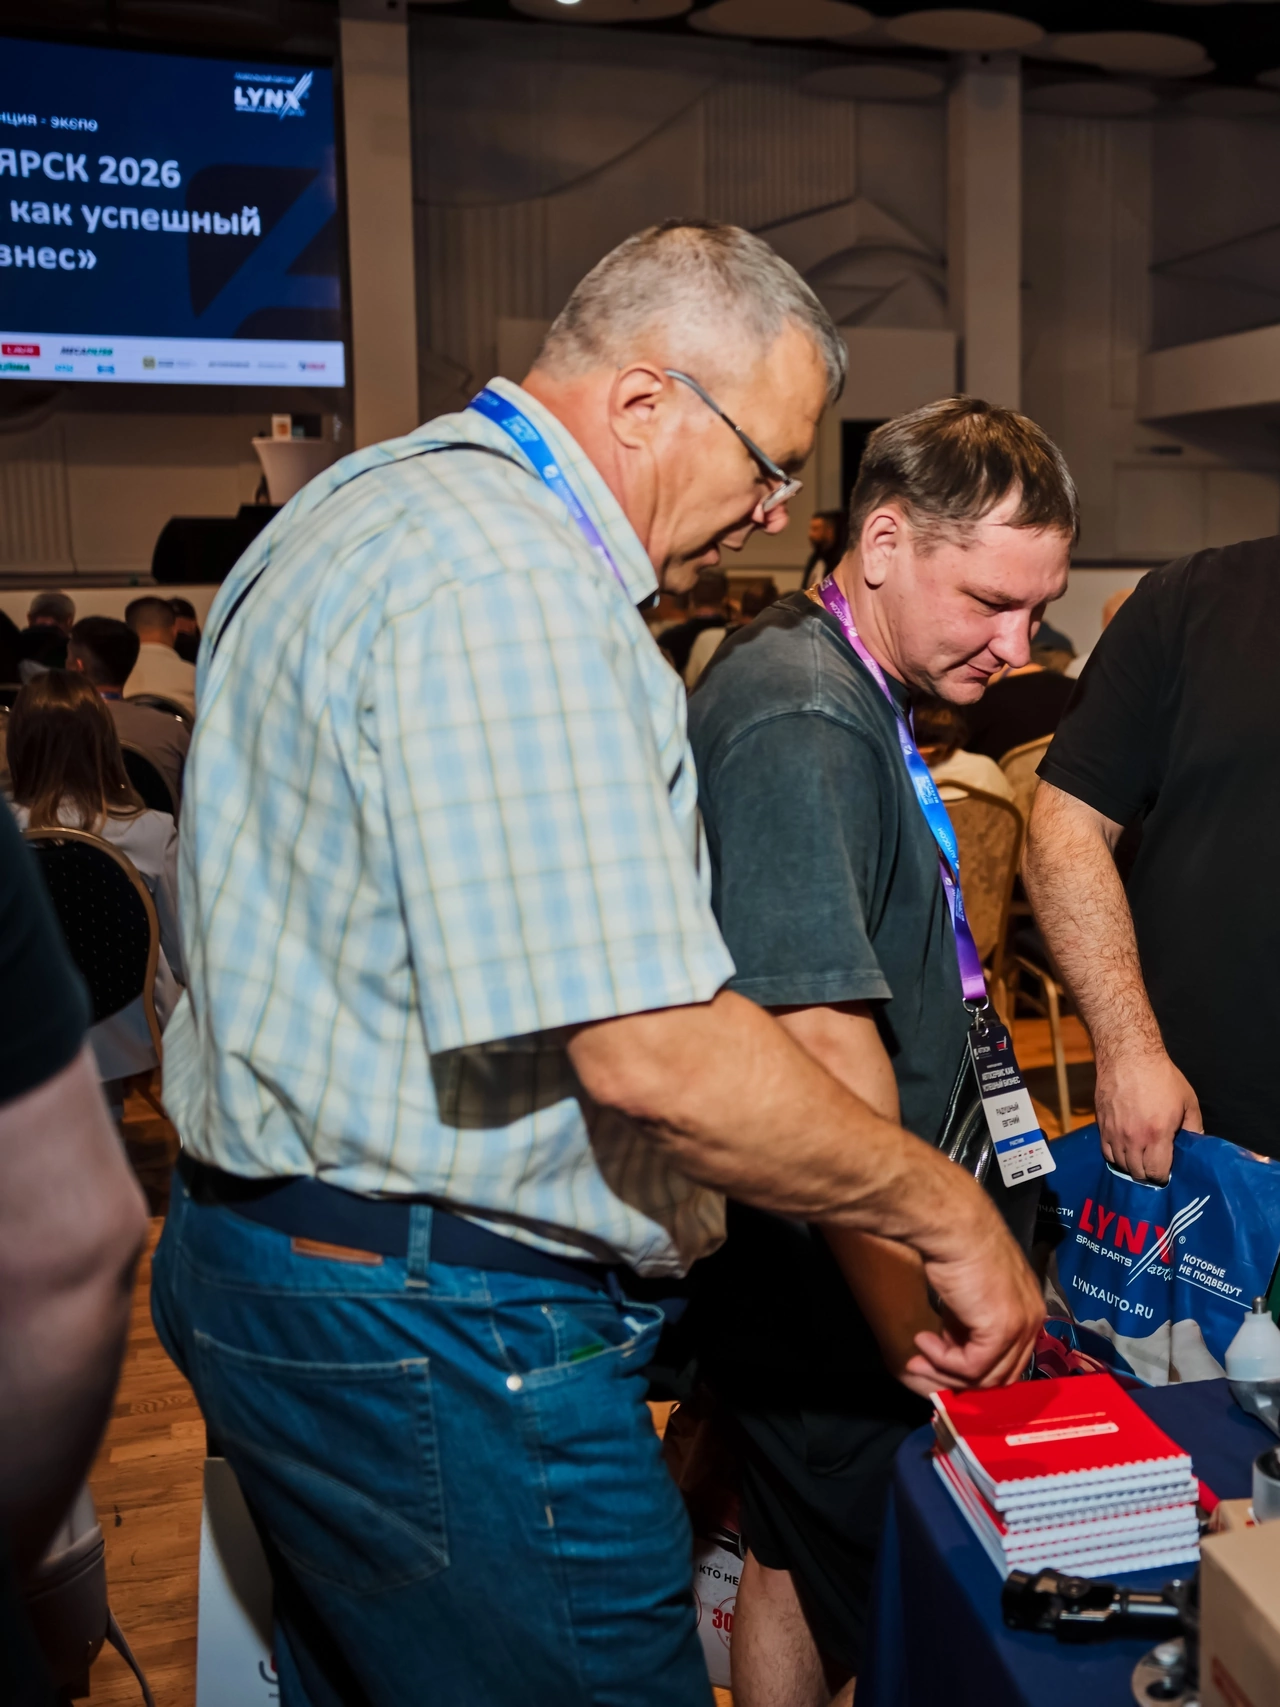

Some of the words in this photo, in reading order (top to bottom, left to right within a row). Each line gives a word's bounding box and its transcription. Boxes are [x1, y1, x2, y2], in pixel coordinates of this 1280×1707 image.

[234, 86, 301, 111] LYNX
[0, 148, 89, 182] ЯРСК
[98, 155, 181, 188] 2026
[10, 200, 72, 226] как
[81, 204, 261, 236] успешный
[830, 601, 852, 629] AUTOCOM
[937, 826, 957, 858] AUTOCOM
[1078, 1198, 1173, 1264] LYNX
[1075, 1234, 1101, 1254] SPARE
[1100, 1248, 1133, 1268] PARTS
[1182, 1253, 1226, 1278] КОТОРЫЕ
[1072, 1274, 1154, 1320] LYNXAUTO.RU
[1178, 1264, 1193, 1277] НЕ
[1192, 1268, 1243, 1298] ПОДВЕДУТ
[699, 1564, 722, 1580] КТО
[724, 1572, 740, 1587] НЕ
